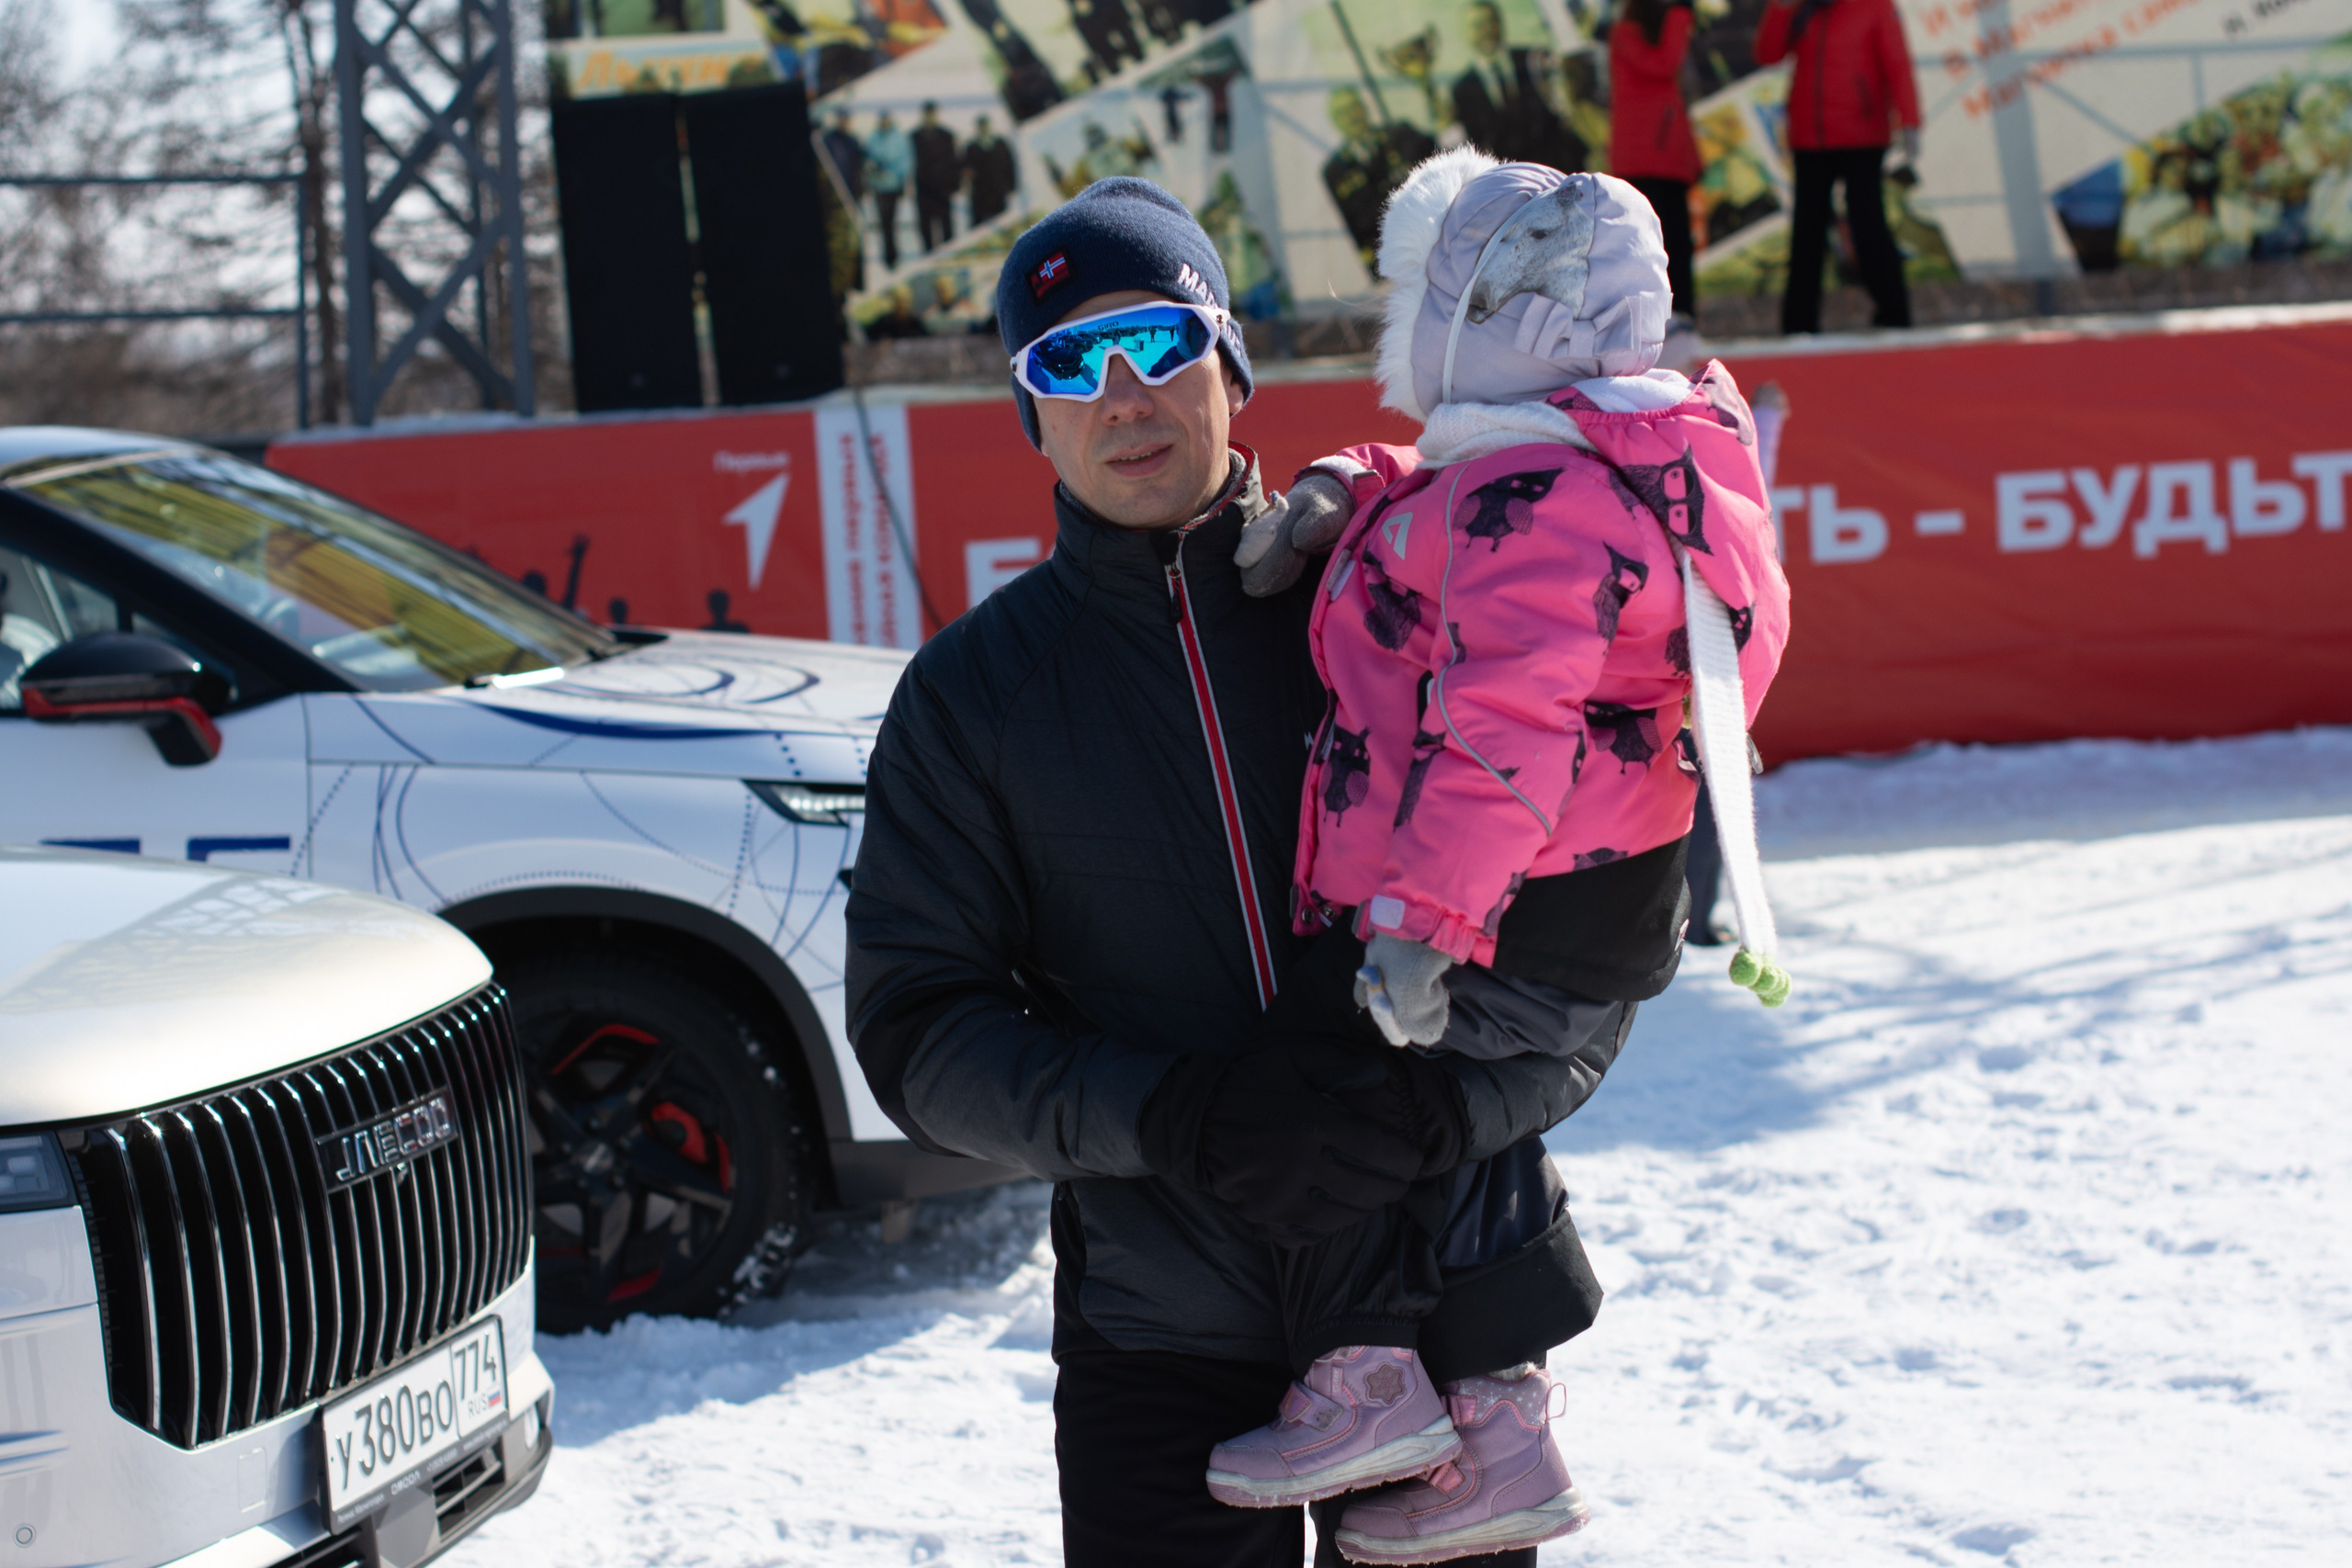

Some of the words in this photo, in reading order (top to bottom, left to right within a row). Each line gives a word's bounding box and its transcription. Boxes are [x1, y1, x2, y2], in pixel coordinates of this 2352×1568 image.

[1098, 321, 1120, 331] GIRO
[335, 1098, 451, 1181] JAECOO
[454, 1331, 497, 1401] 774
[467, 1394, 488, 1417] RUS
